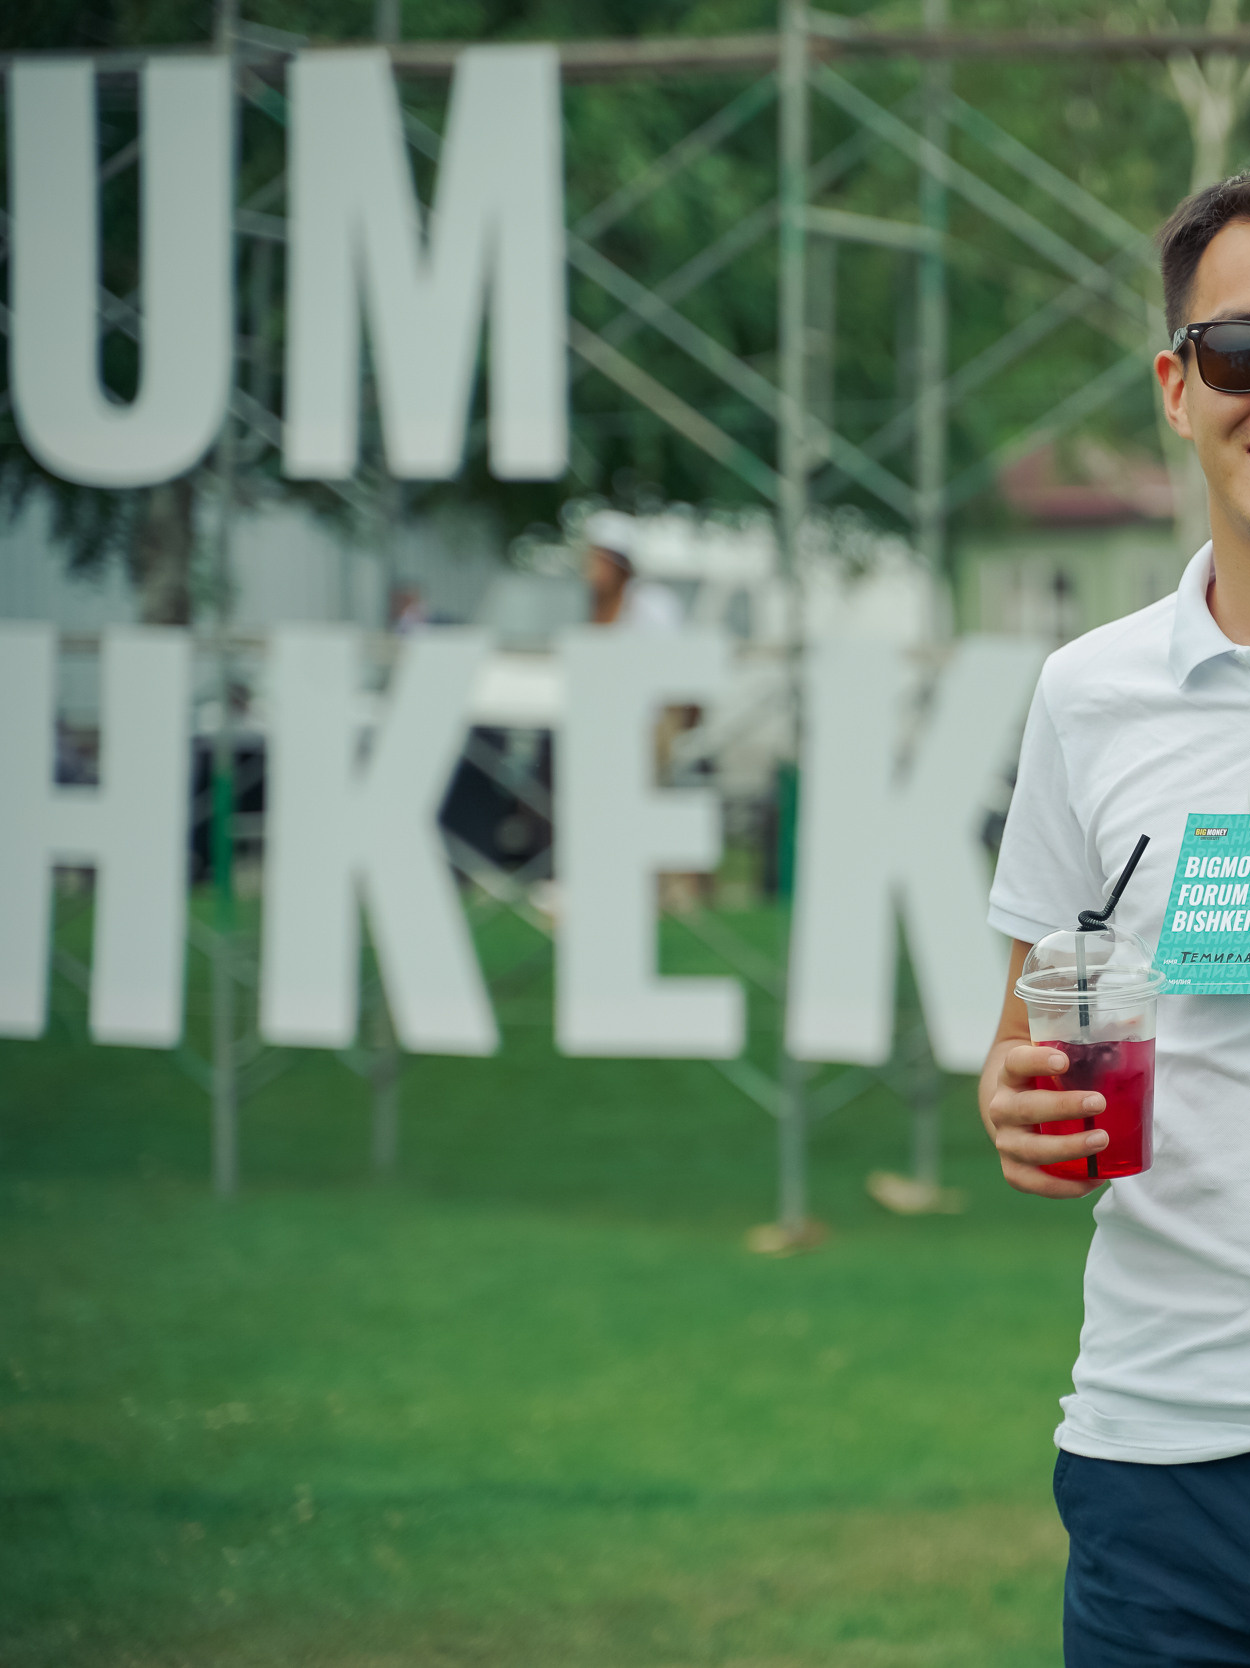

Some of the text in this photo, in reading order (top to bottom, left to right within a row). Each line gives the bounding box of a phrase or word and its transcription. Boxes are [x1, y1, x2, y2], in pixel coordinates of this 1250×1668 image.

[1195, 828, 1228, 836] BIG MONEY
[1177, 883, 1249, 906] FORUM
